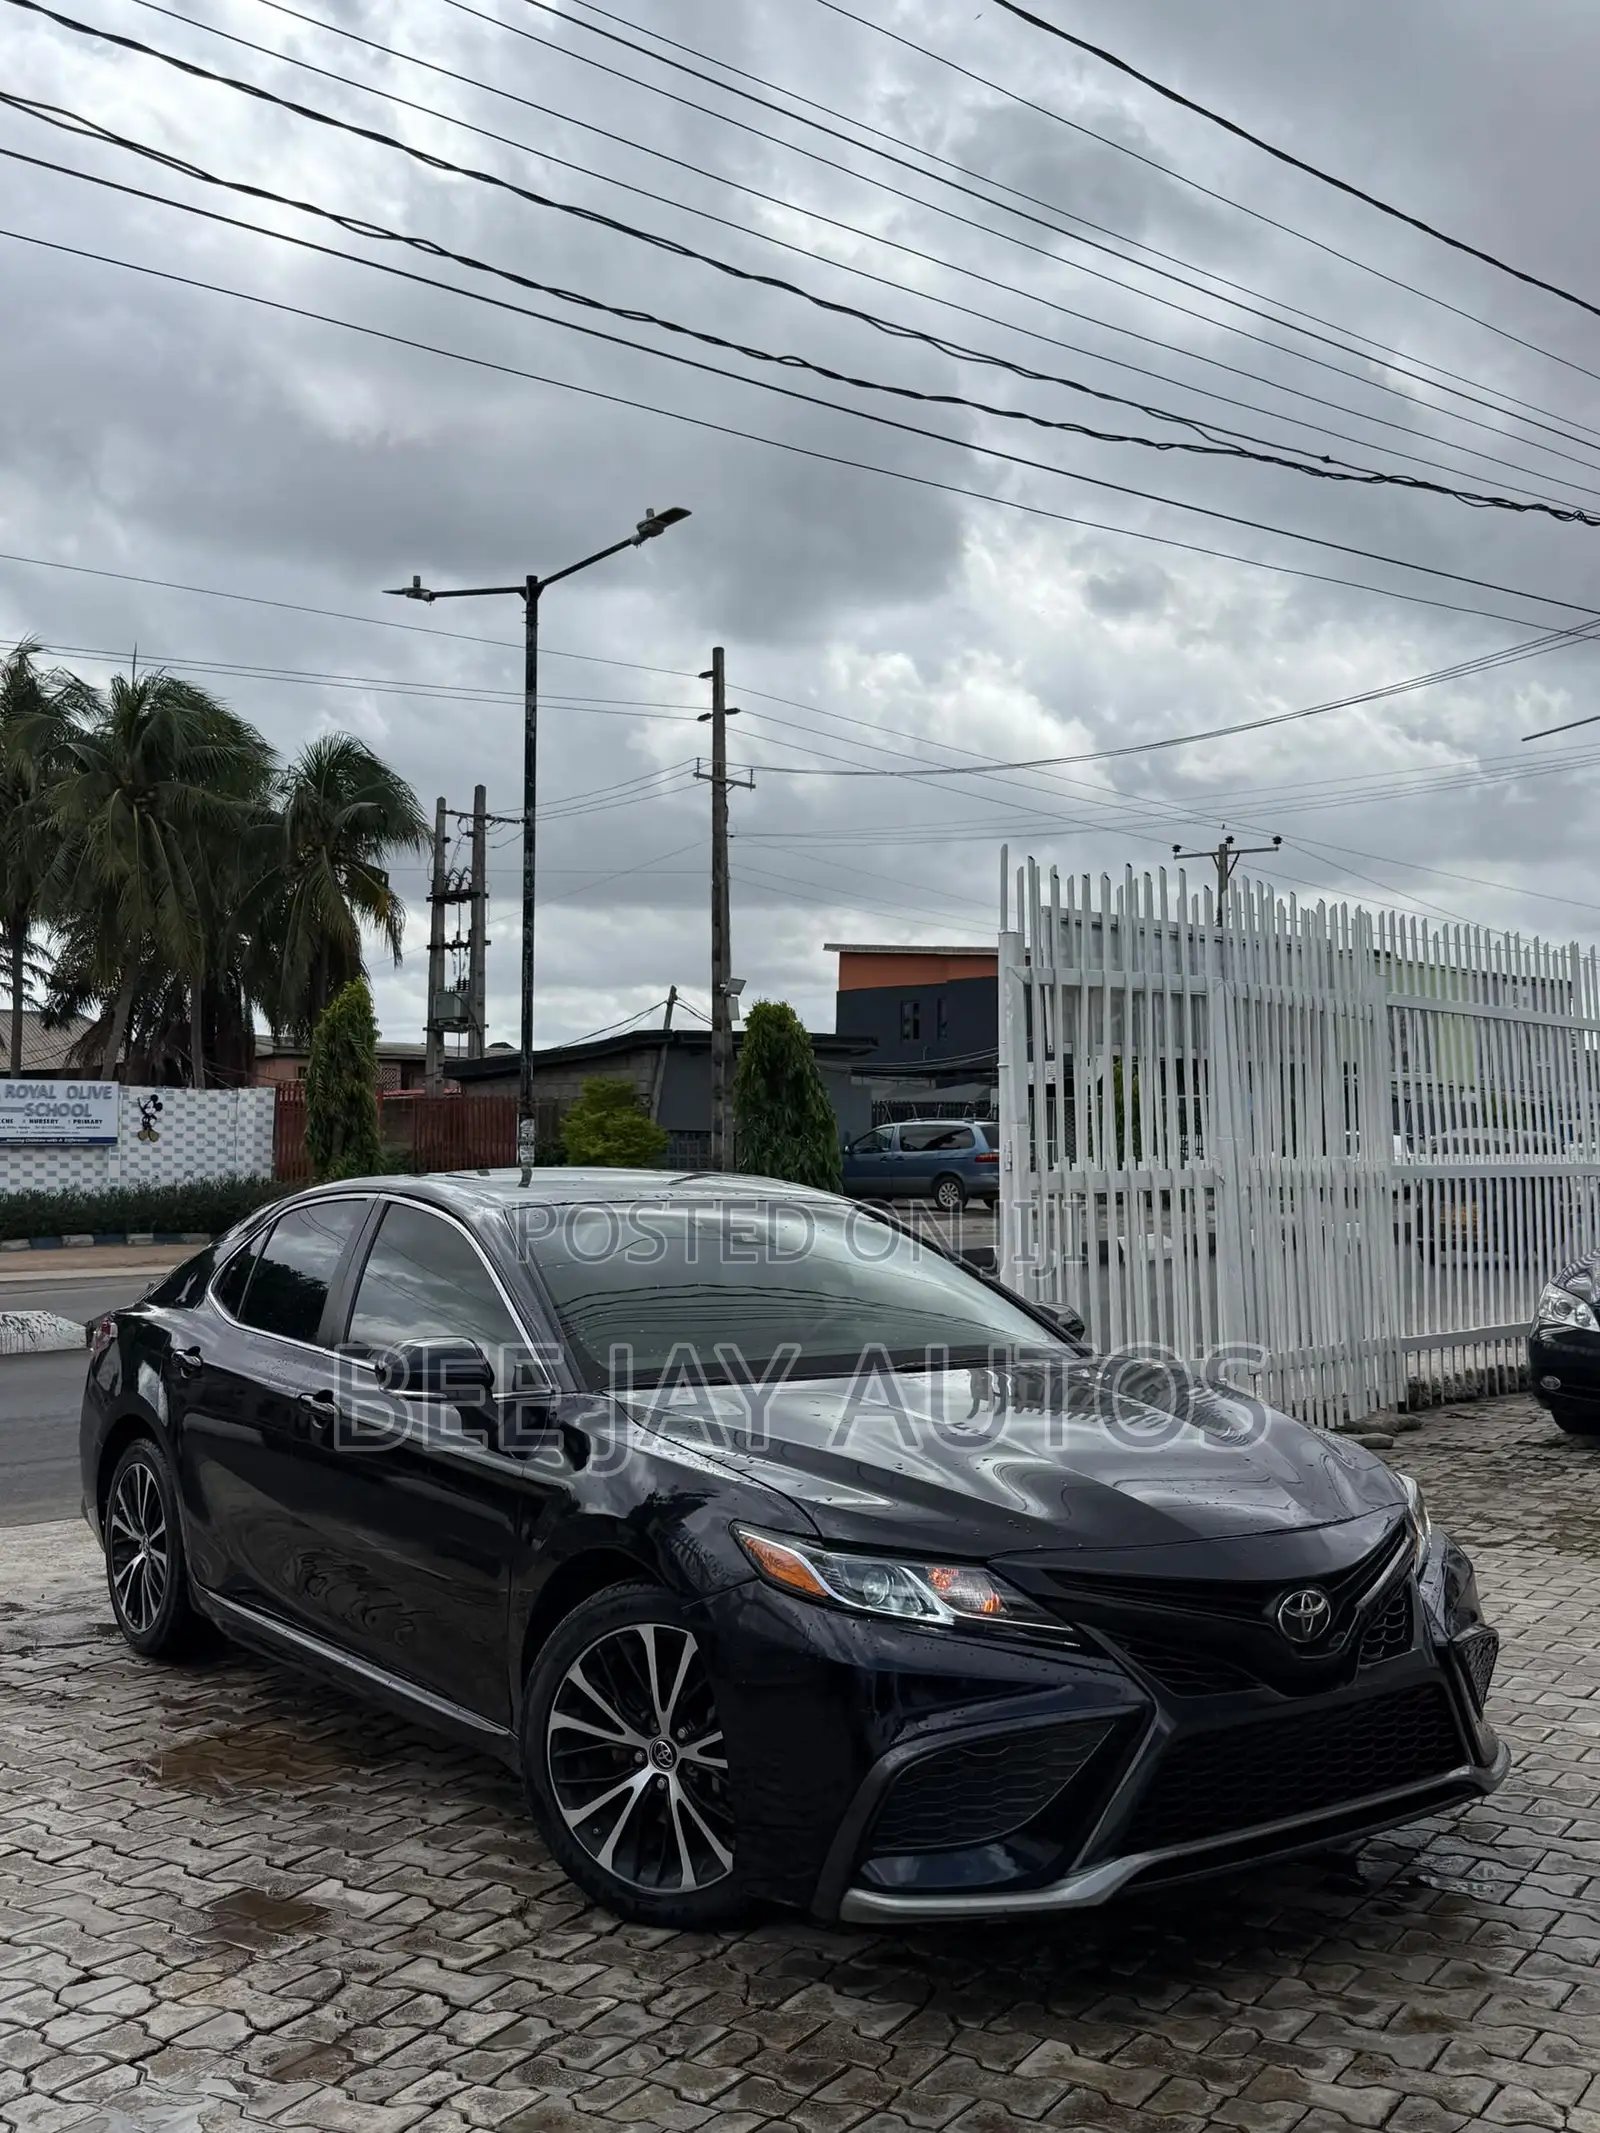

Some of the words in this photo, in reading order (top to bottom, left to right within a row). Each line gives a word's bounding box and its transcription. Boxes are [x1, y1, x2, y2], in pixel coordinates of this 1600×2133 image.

[4, 1084, 57, 1099] ROYAL
[66, 1085, 113, 1100] OLIVE
[24, 1102, 92, 1118] SCHOOL
